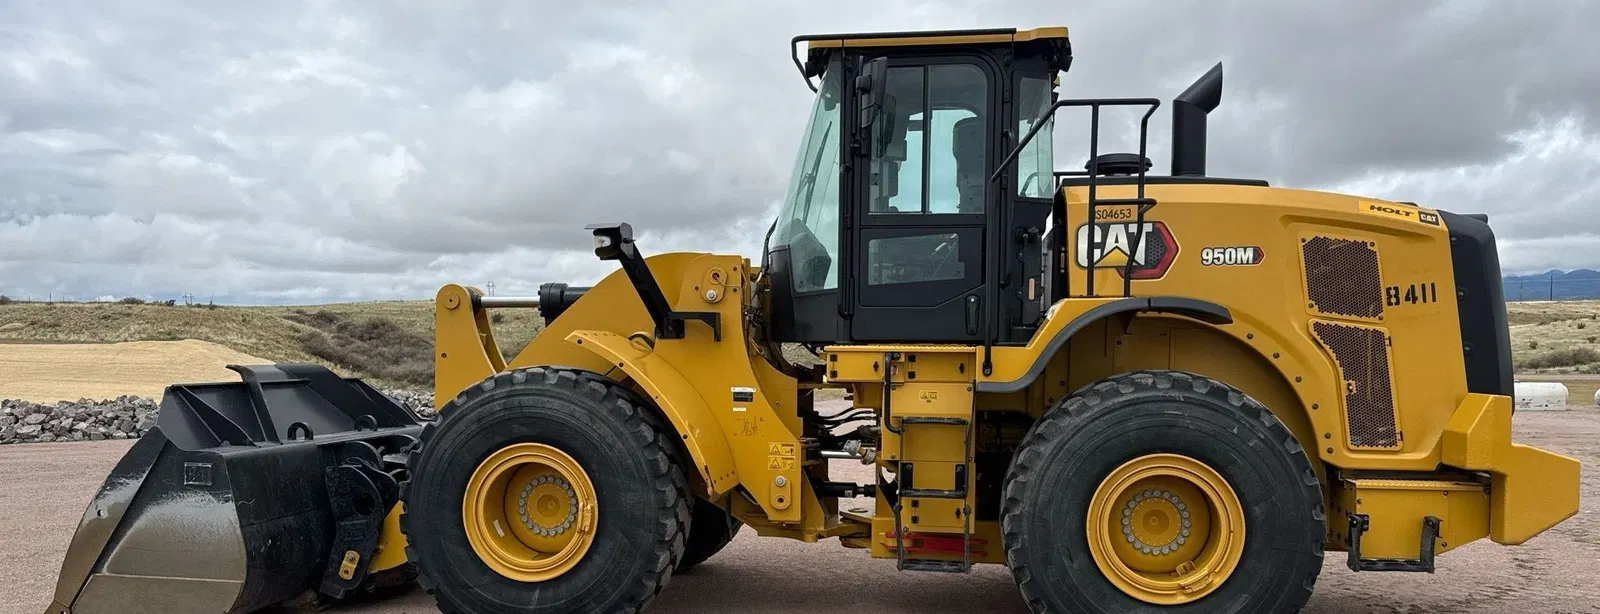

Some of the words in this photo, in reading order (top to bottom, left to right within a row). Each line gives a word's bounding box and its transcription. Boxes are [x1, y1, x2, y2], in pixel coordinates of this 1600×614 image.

[1095, 208, 1132, 219] S04653
[1370, 205, 1414, 217] HOLT
[1420, 214, 1437, 222] CAT
[1078, 223, 1153, 267] CAT
[1202, 247, 1254, 265] 950M
[1386, 282, 1436, 306] 8411
